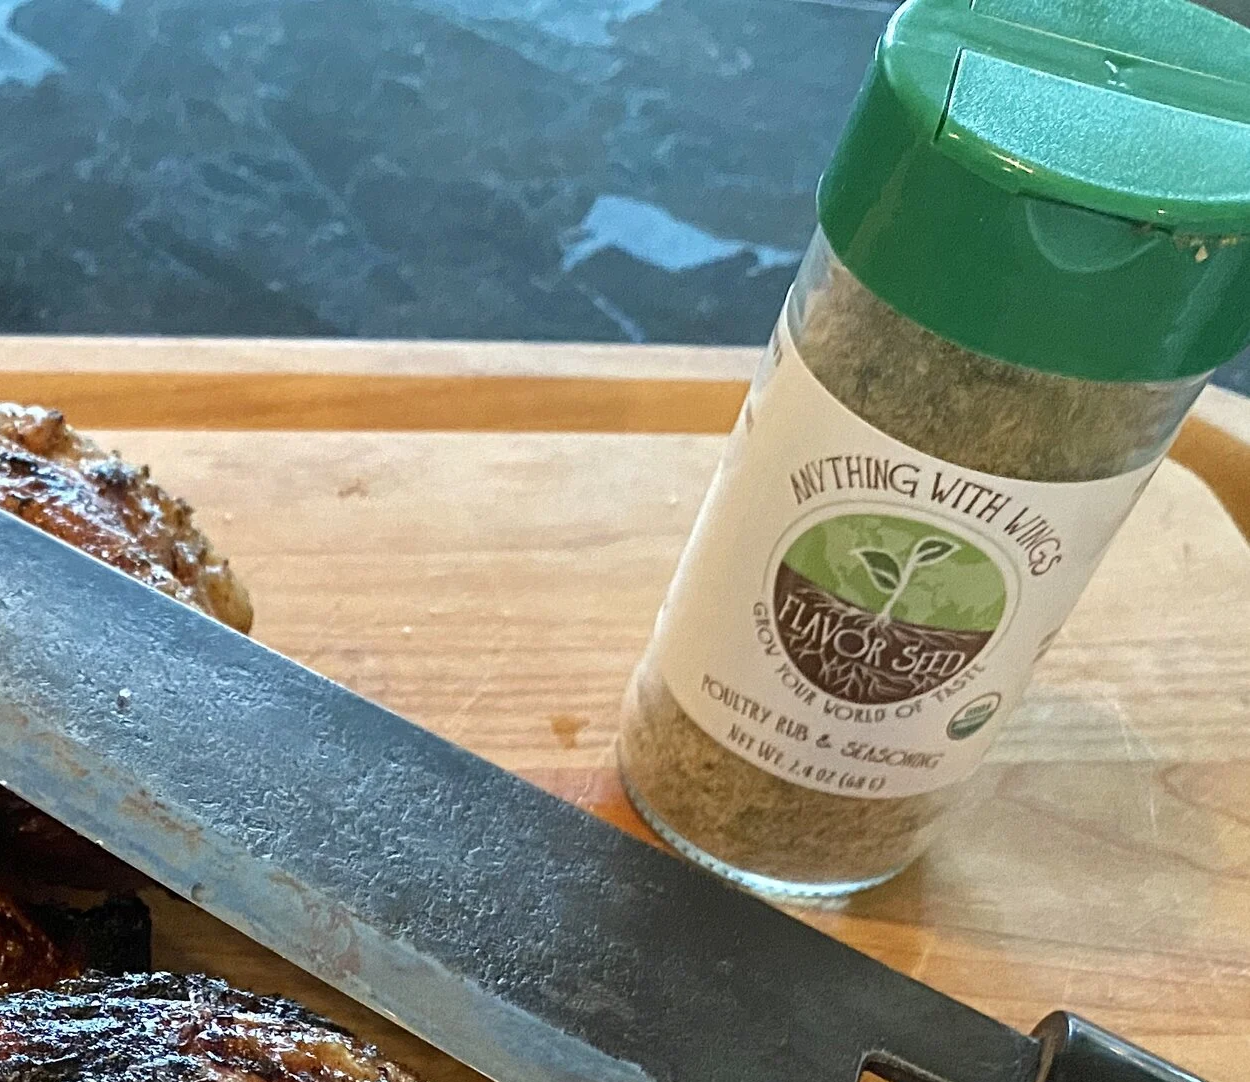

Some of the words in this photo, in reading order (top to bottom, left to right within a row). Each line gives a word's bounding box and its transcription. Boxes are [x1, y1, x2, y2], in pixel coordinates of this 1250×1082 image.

[790, 455, 921, 505] ANYTHING
[930, 471, 1013, 523] WITH
[1003, 507, 1062, 576] WINGS
[752, 602, 781, 656] GROW
[775, 662, 817, 706] YOUR
[823, 706, 886, 723] WORLD
[895, 699, 922, 719] OF
[932, 664, 986, 704] TASTE
[778, 594, 887, 667] FLAVOR
[701, 673, 772, 724] POULTRY
[775, 715, 809, 742] RUB
[815, 734, 831, 749] &
[840, 741, 943, 769] SEASONING
[727, 723, 754, 750] NET
